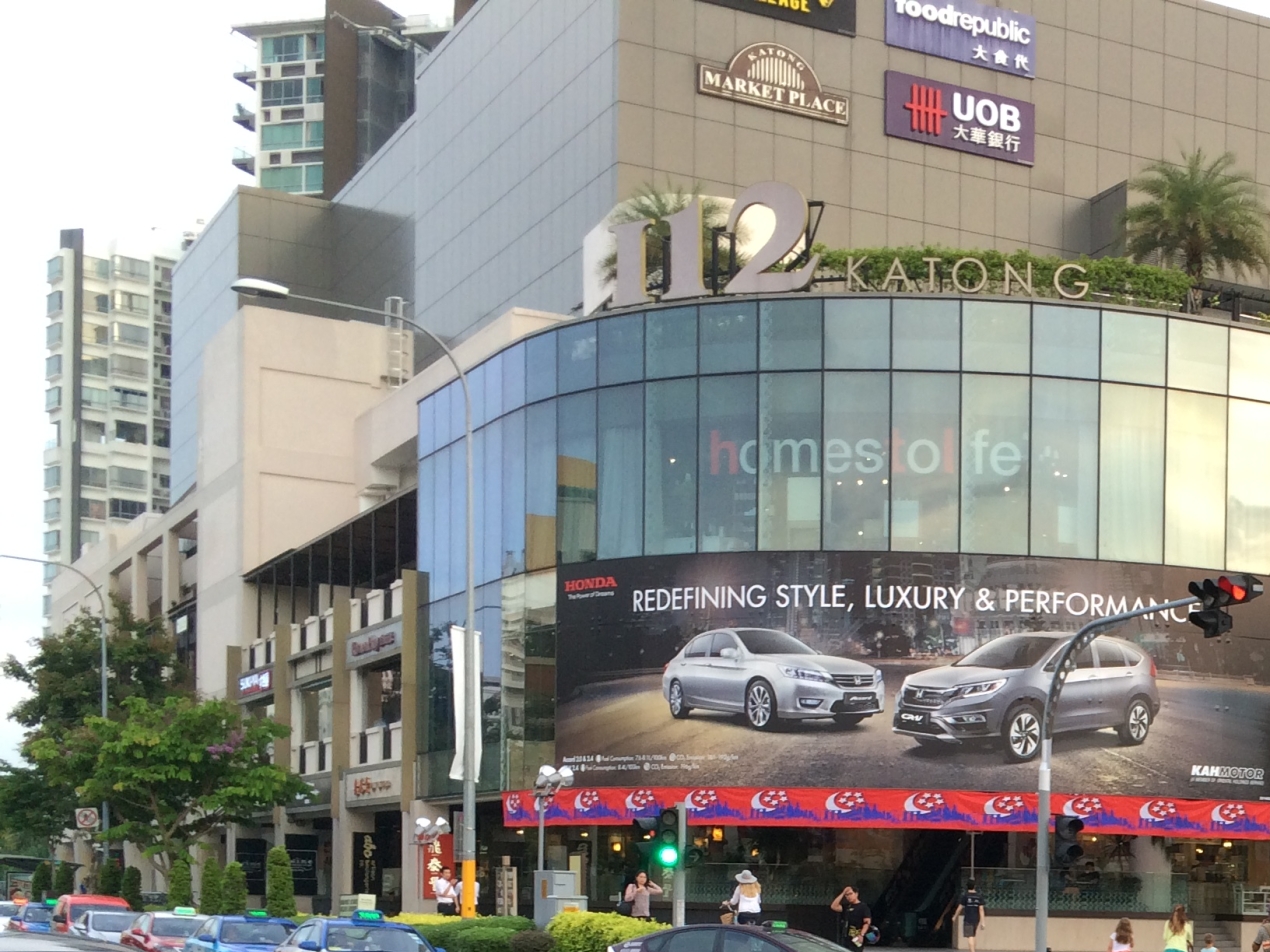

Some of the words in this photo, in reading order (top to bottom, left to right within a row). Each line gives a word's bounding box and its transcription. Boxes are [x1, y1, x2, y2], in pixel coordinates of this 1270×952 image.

[895, 0, 1031, 44] foodrepublic
[747, 47, 805, 71] KATONG
[972, 44, 1030, 72] 大食代
[704, 71, 785, 102] MARKET
[789, 90, 846, 116] PLACE
[953, 92, 1021, 132] UOB
[953, 124, 1021, 152] 大華銀行
[609, 181, 820, 308] 112
[847, 255, 1090, 299] KATONG
[564, 576, 618, 592] HONDA
[633, 584, 766, 613] REDEFINING
[776, 584, 854, 612] STYLE,
[865, 586, 966, 610] LUXURY
[975, 587, 995, 611] &
[1005, 589, 1201, 623] PERFORMANCE
